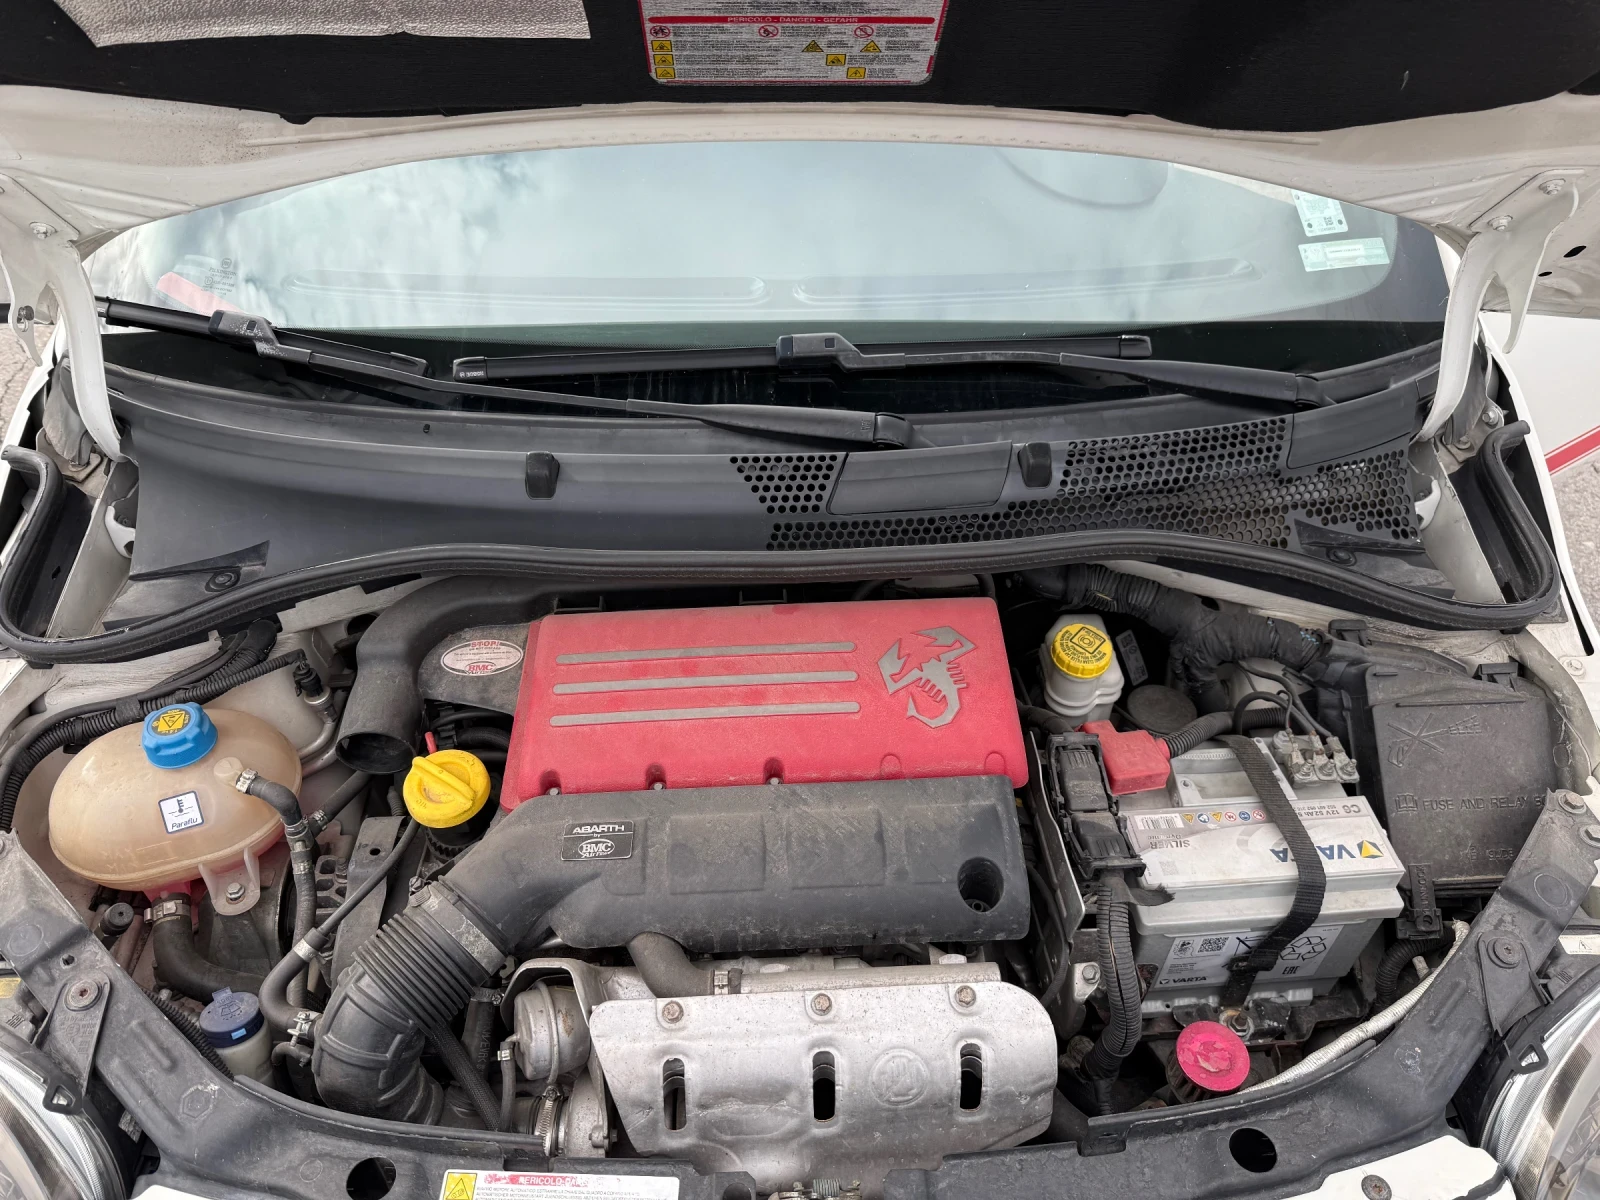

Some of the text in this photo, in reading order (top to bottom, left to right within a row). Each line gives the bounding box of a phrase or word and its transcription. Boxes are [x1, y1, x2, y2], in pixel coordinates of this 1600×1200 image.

[1423, 799, 1454, 810] FUSE
[1460, 798, 1484, 810] AND
[1490, 796, 1528, 809] RELAY
[1342, 804, 1361, 814] C6
[171, 818, 198, 830] Paraflu
[572, 825, 624, 834] ABARTH
[582, 843, 611, 853] BMC
[1150, 839, 1190, 849] SILVER
[1171, 976, 1207, 984] VARTA
